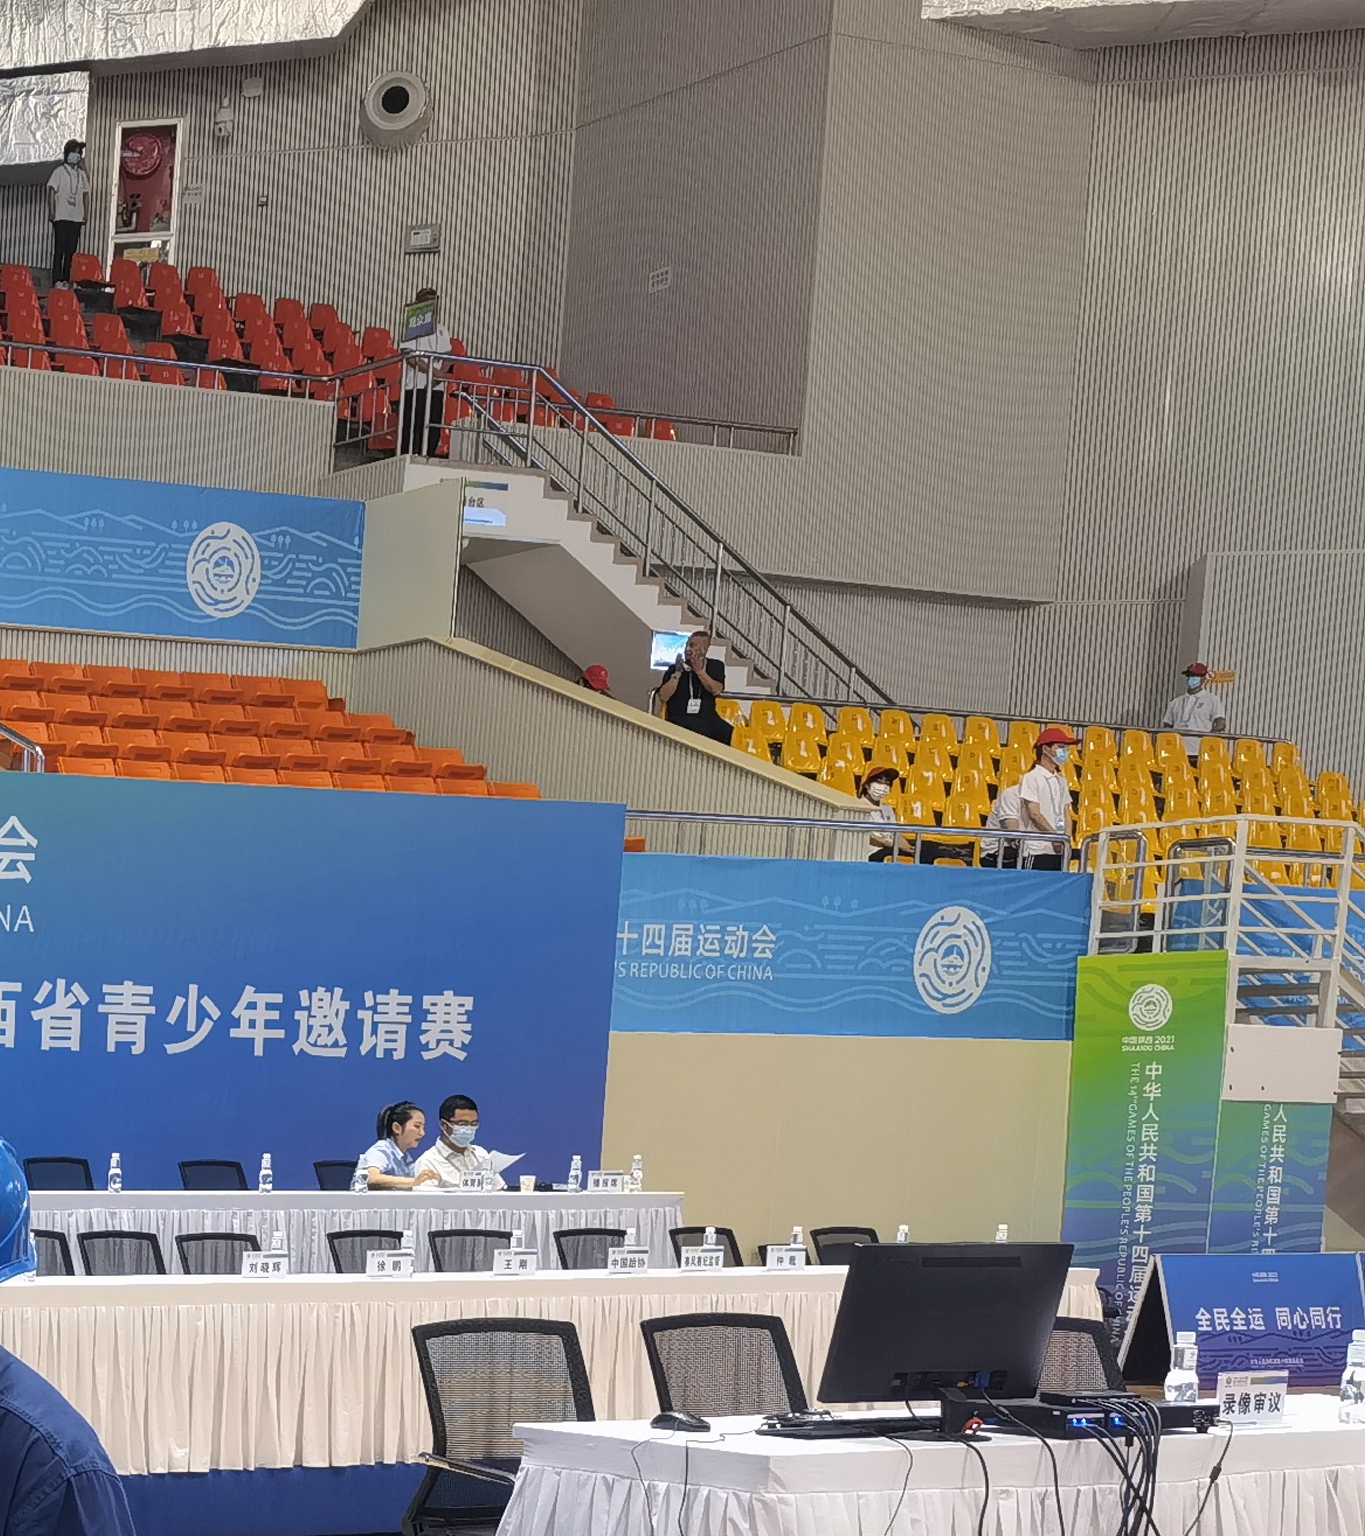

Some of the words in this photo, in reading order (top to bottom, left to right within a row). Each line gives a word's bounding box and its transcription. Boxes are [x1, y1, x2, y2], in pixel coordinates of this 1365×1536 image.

[617, 921, 776, 959] 十四届运动会
[630, 962, 701, 979] REPUBLIC
[705, 964, 725, 979] OF
[728, 965, 773, 981] CHINA
[1130, 1062, 1140, 1083] THE
[1126, 1144, 1135, 1159] OF
[1260, 1145, 1267, 1160] OF
[1124, 1161, 1134, 1181] THE
[1120, 1184, 1132, 1236] PEOPLE'S
[1195, 1306, 1266, 1331] 全民全运
[1276, 1305, 1343, 1331] 同心同行
[1222, 1392, 1281, 1416] 录像审议
